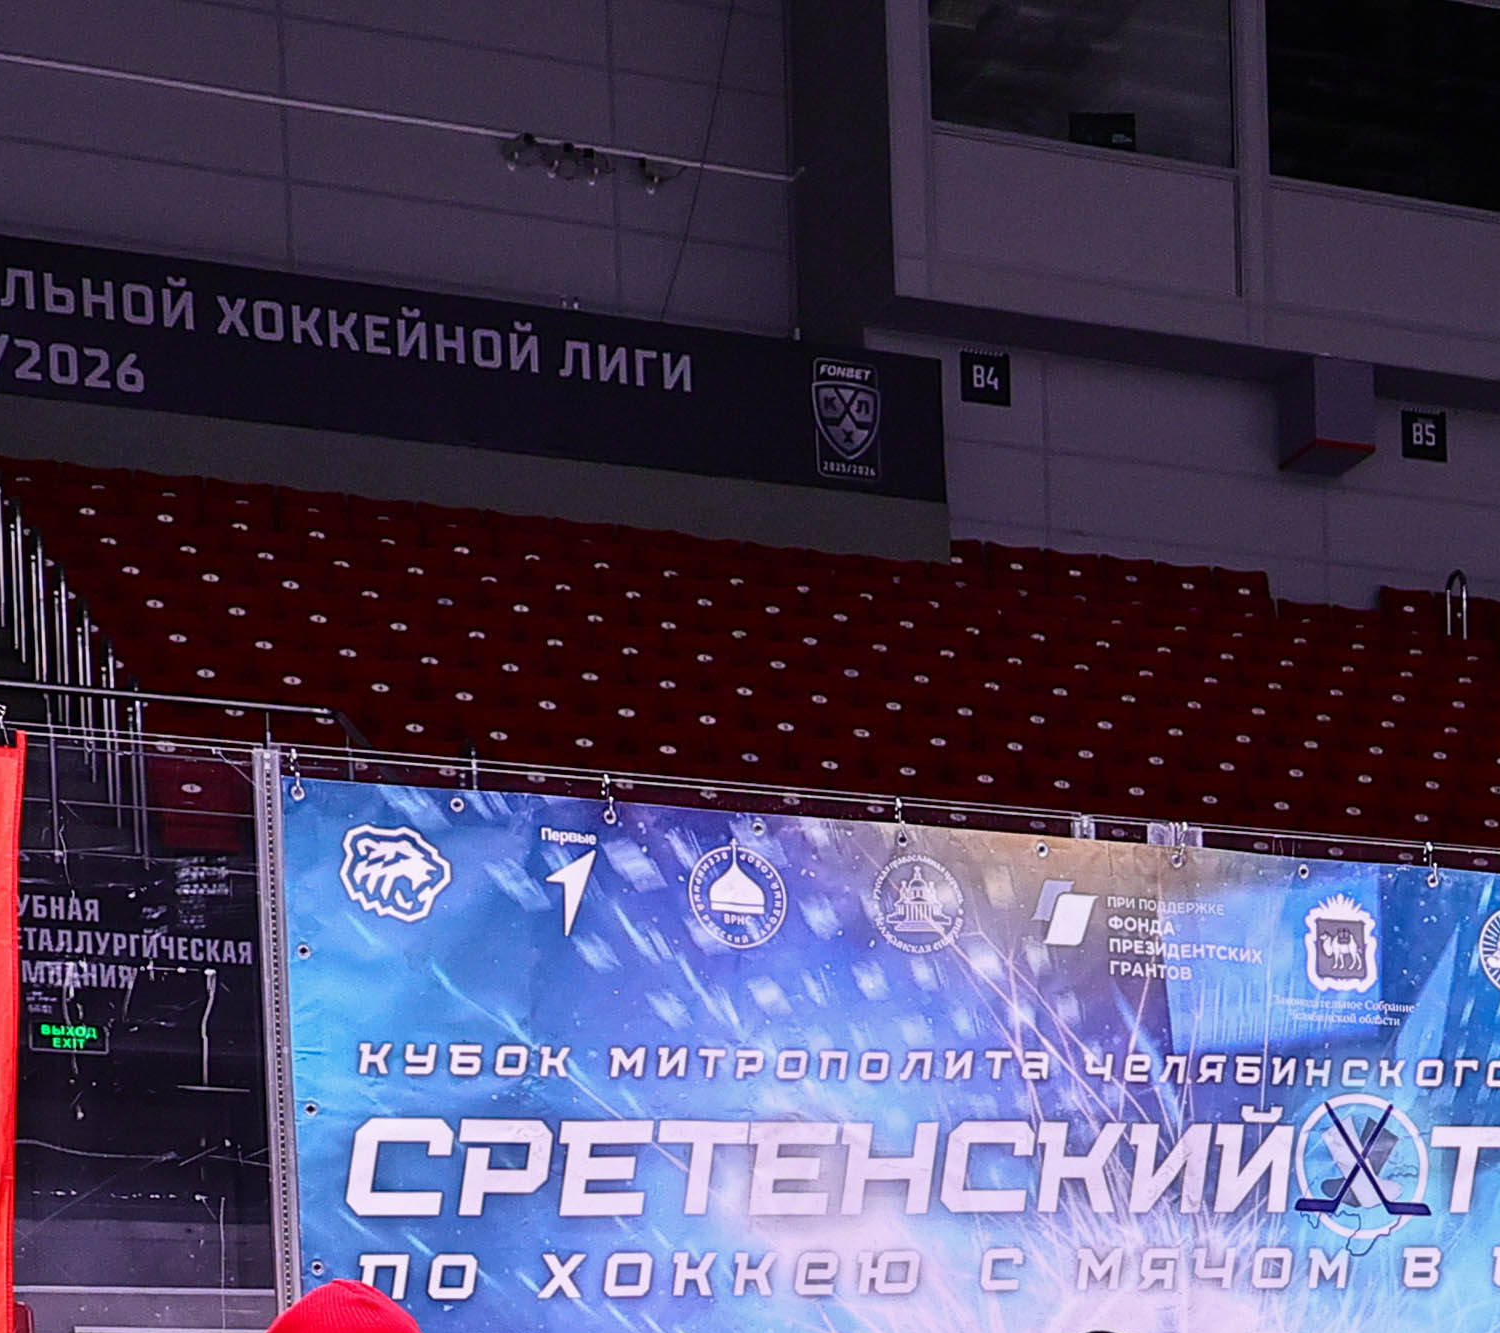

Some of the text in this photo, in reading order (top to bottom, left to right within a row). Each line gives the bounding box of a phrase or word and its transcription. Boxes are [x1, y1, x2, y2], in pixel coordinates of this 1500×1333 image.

[217, 294, 540, 374] ХОККЕЙНОЙ
[559, 340, 694, 393] ЛИГИ
[819, 364, 872, 381] FONBET
[540, 826, 598, 847] Первые
[19, 894, 100, 923] УБНАЯ
[1107, 894, 1225, 916] ПРИ ПОДДЕРЖКЕ
[1108, 914, 1176, 937] ФОНДА
[19, 926, 254, 965] ТАЛЛУРГИЧЕСКАЯ
[1109, 938, 1264, 966] ПРЕЗИДЕНТСКИХ
[22, 959, 137, 990] МПАНИЯ
[1109, 960, 1193, 982] ГРАНТОВ
[40, 1024, 98, 1040] ВЫХОД
[52, 1037, 85, 1050] EXIT
[357, 1042, 571, 1079] КУБОК
[345, 1104, 1297, 1218] СРЕТЕНСКИЙ
[358, 1252, 479, 1300] ПО
[1076, 1246, 1351, 1291] МЯЧОМ
[1401, 1246, 1442, 1289] В
